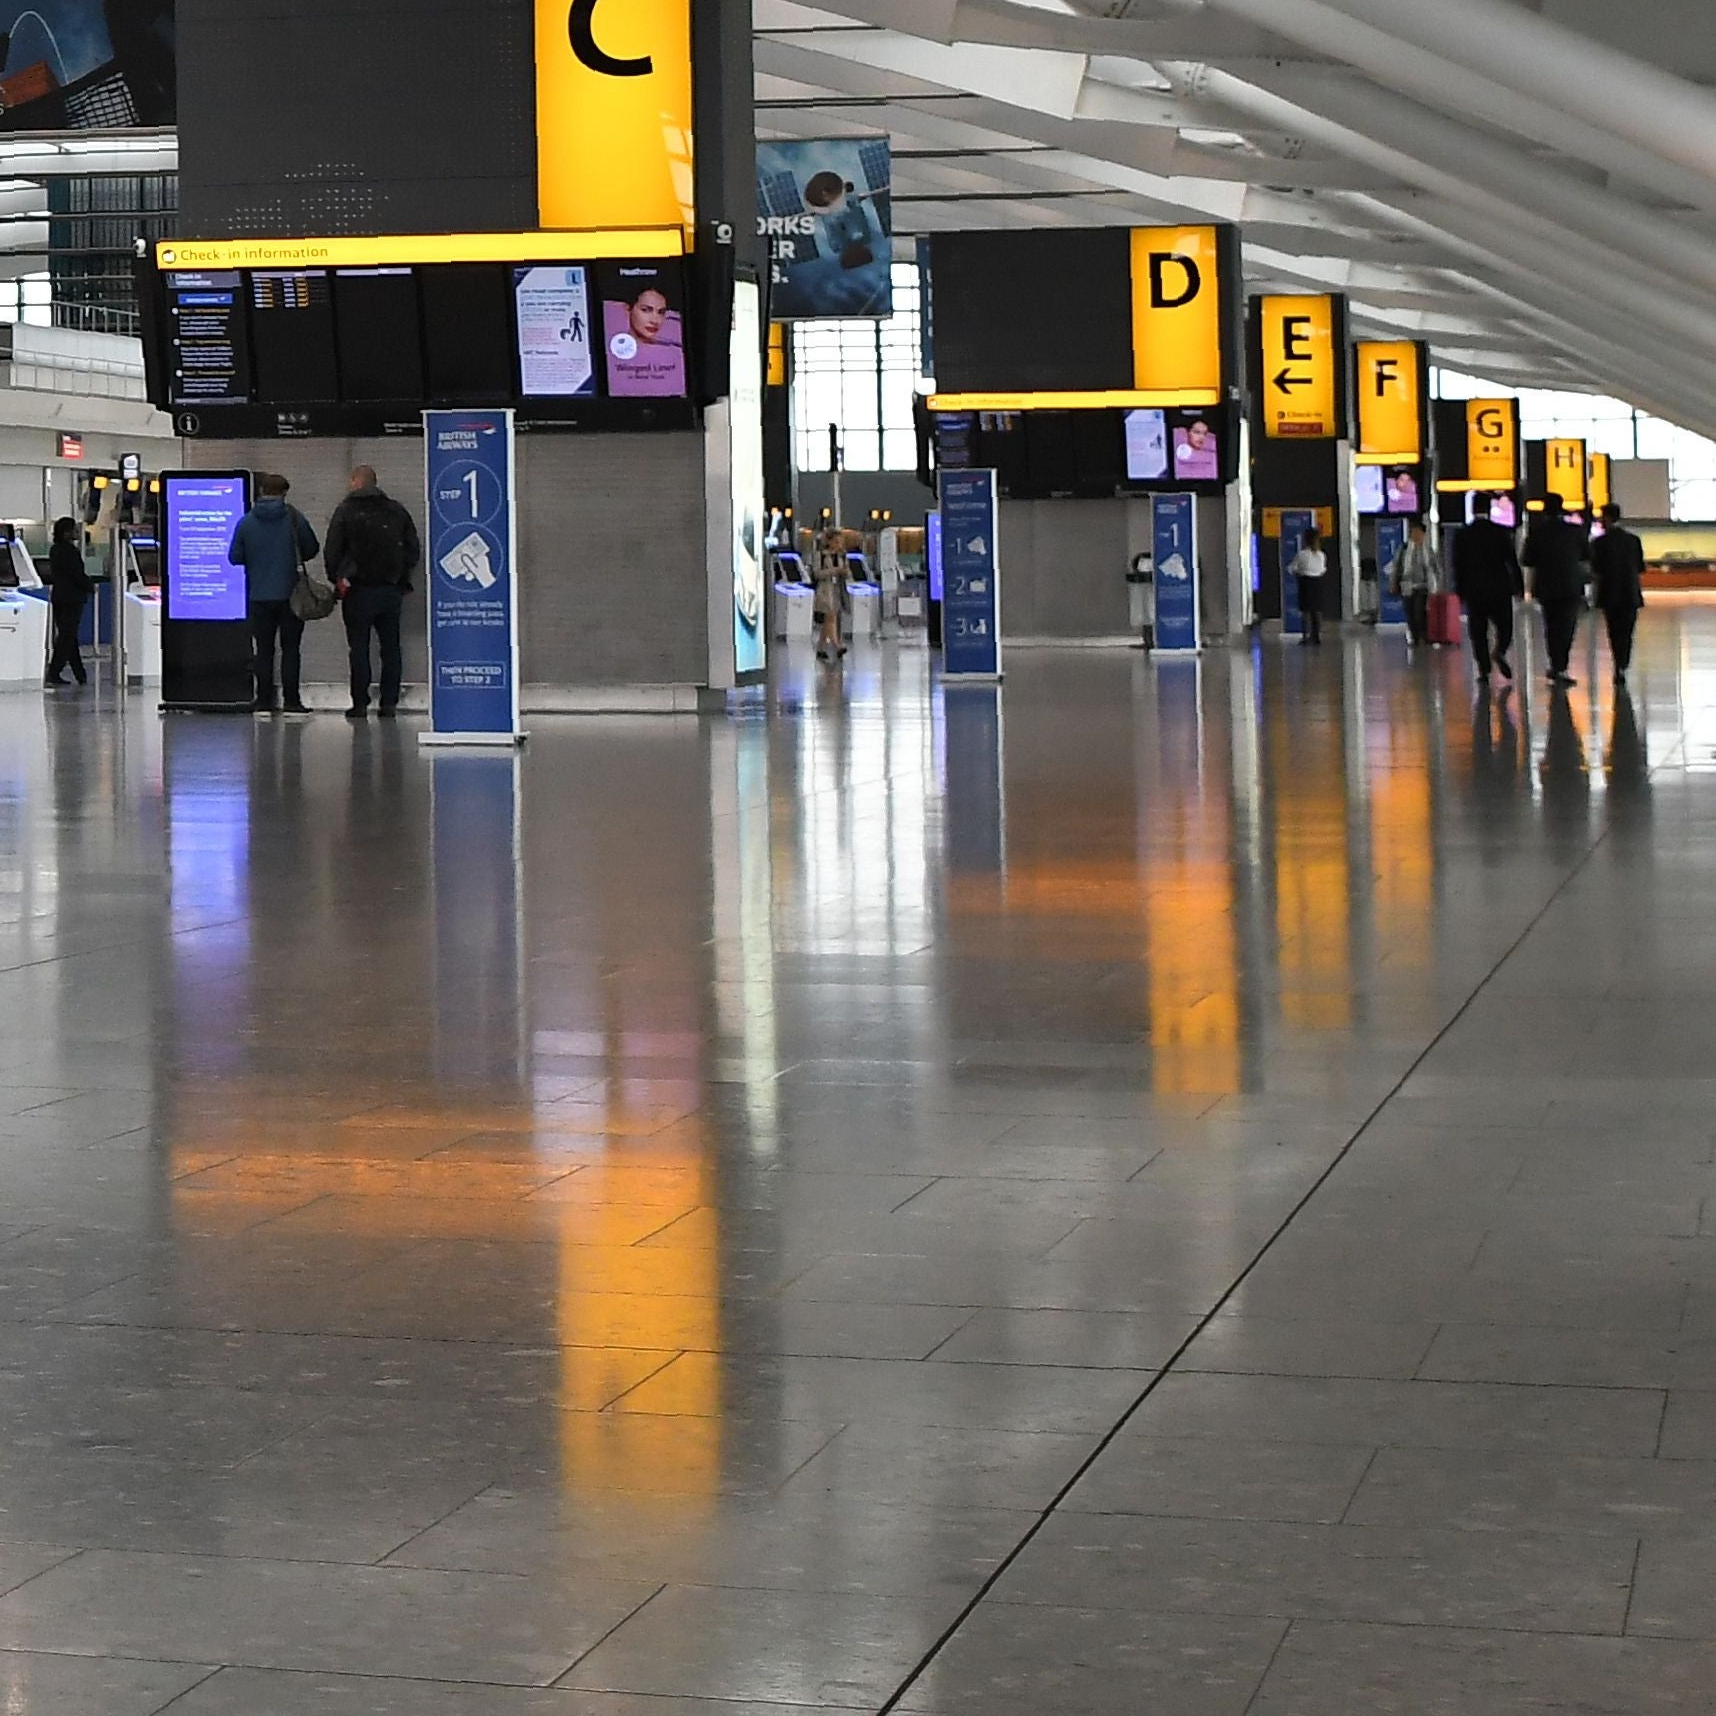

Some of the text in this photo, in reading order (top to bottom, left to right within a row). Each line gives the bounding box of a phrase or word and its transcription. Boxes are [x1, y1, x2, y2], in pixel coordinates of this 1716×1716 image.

[180, 247, 328, 261] Check-in information
[1148, 252, 1201, 309] D
[1282, 316, 1313, 360] E
[1376, 359, 1398, 397] F
[438, 431, 477, 441] BRITISH
[1476, 409, 1504, 439] G
[437, 441, 478, 450] AIRWAYS
[1554, 446, 1574, 468] H
[463, 470, 478, 518] 1
